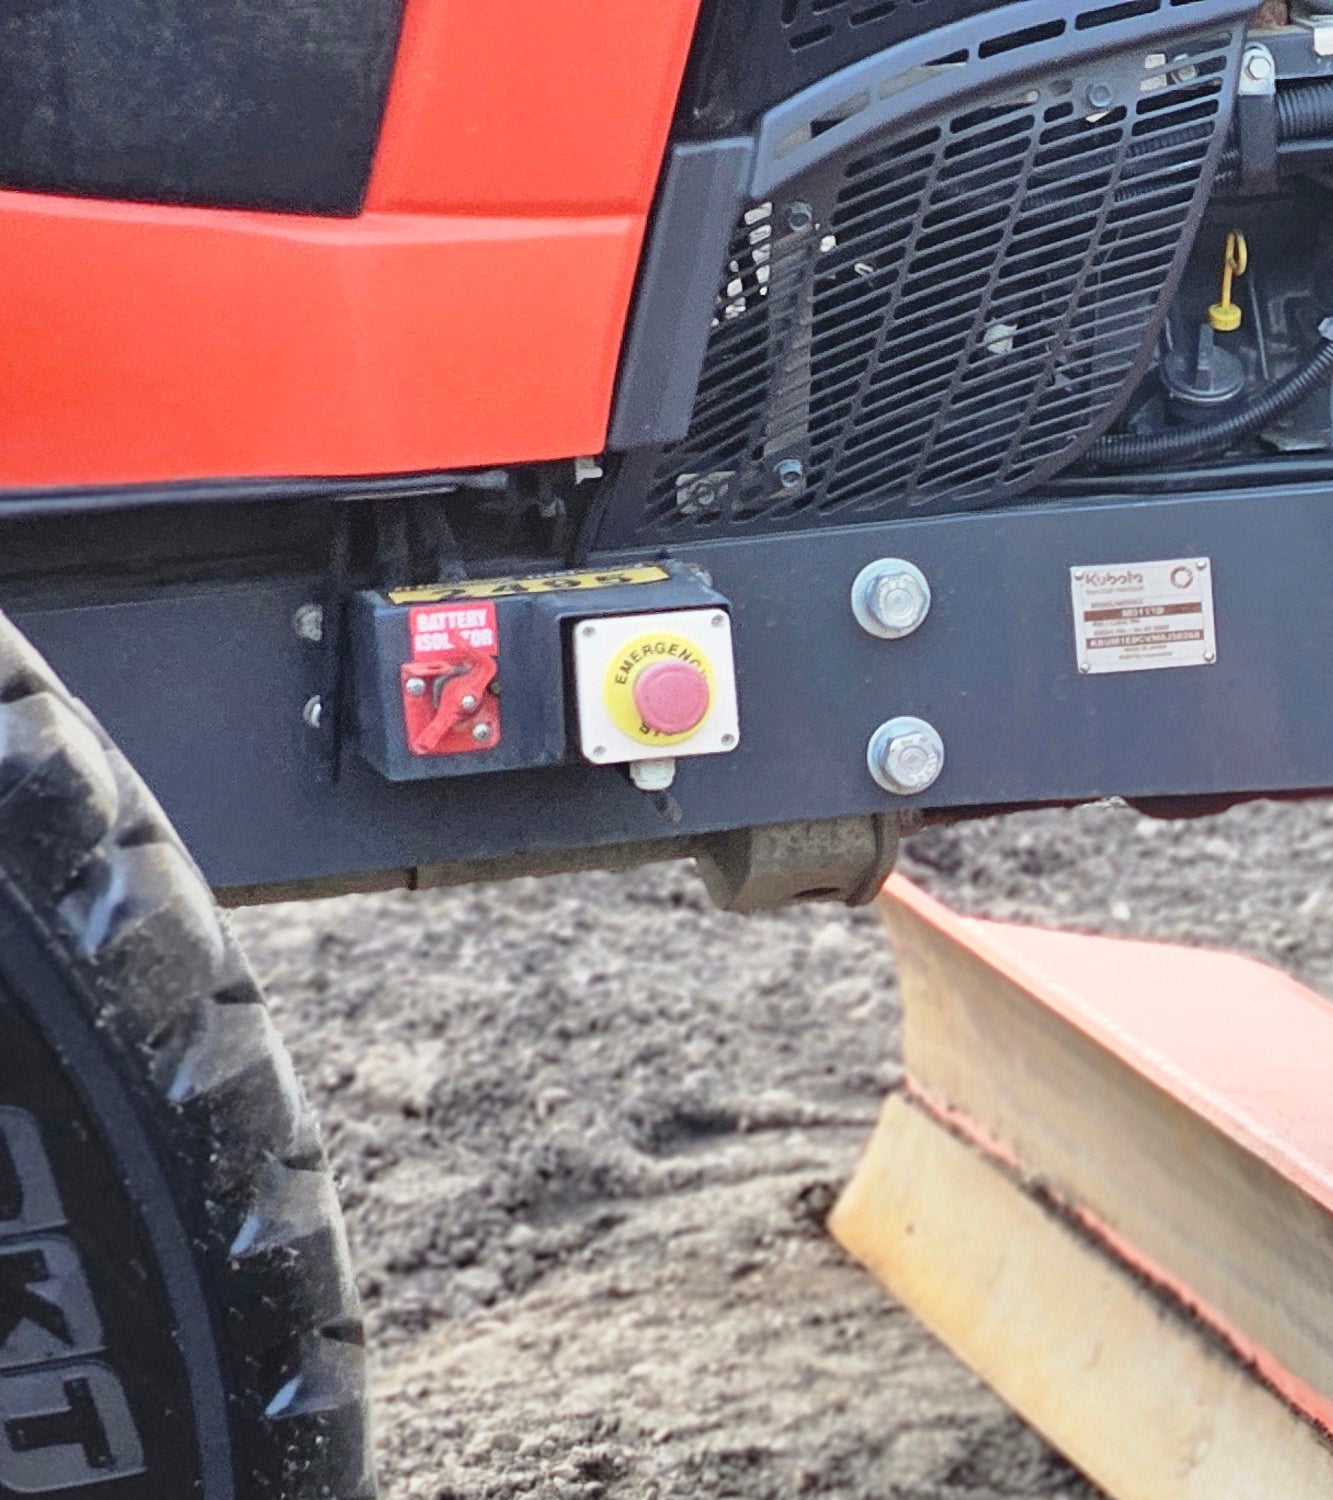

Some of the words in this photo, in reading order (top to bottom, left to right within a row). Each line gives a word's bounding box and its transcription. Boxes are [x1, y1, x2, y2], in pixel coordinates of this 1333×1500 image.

[1086, 570, 1144, 587] Kubota
[417, 609, 487, 632] BATTERY
[414, 628, 493, 652] ISOLTOR
[615, 642, 706, 685] EMERGENC
